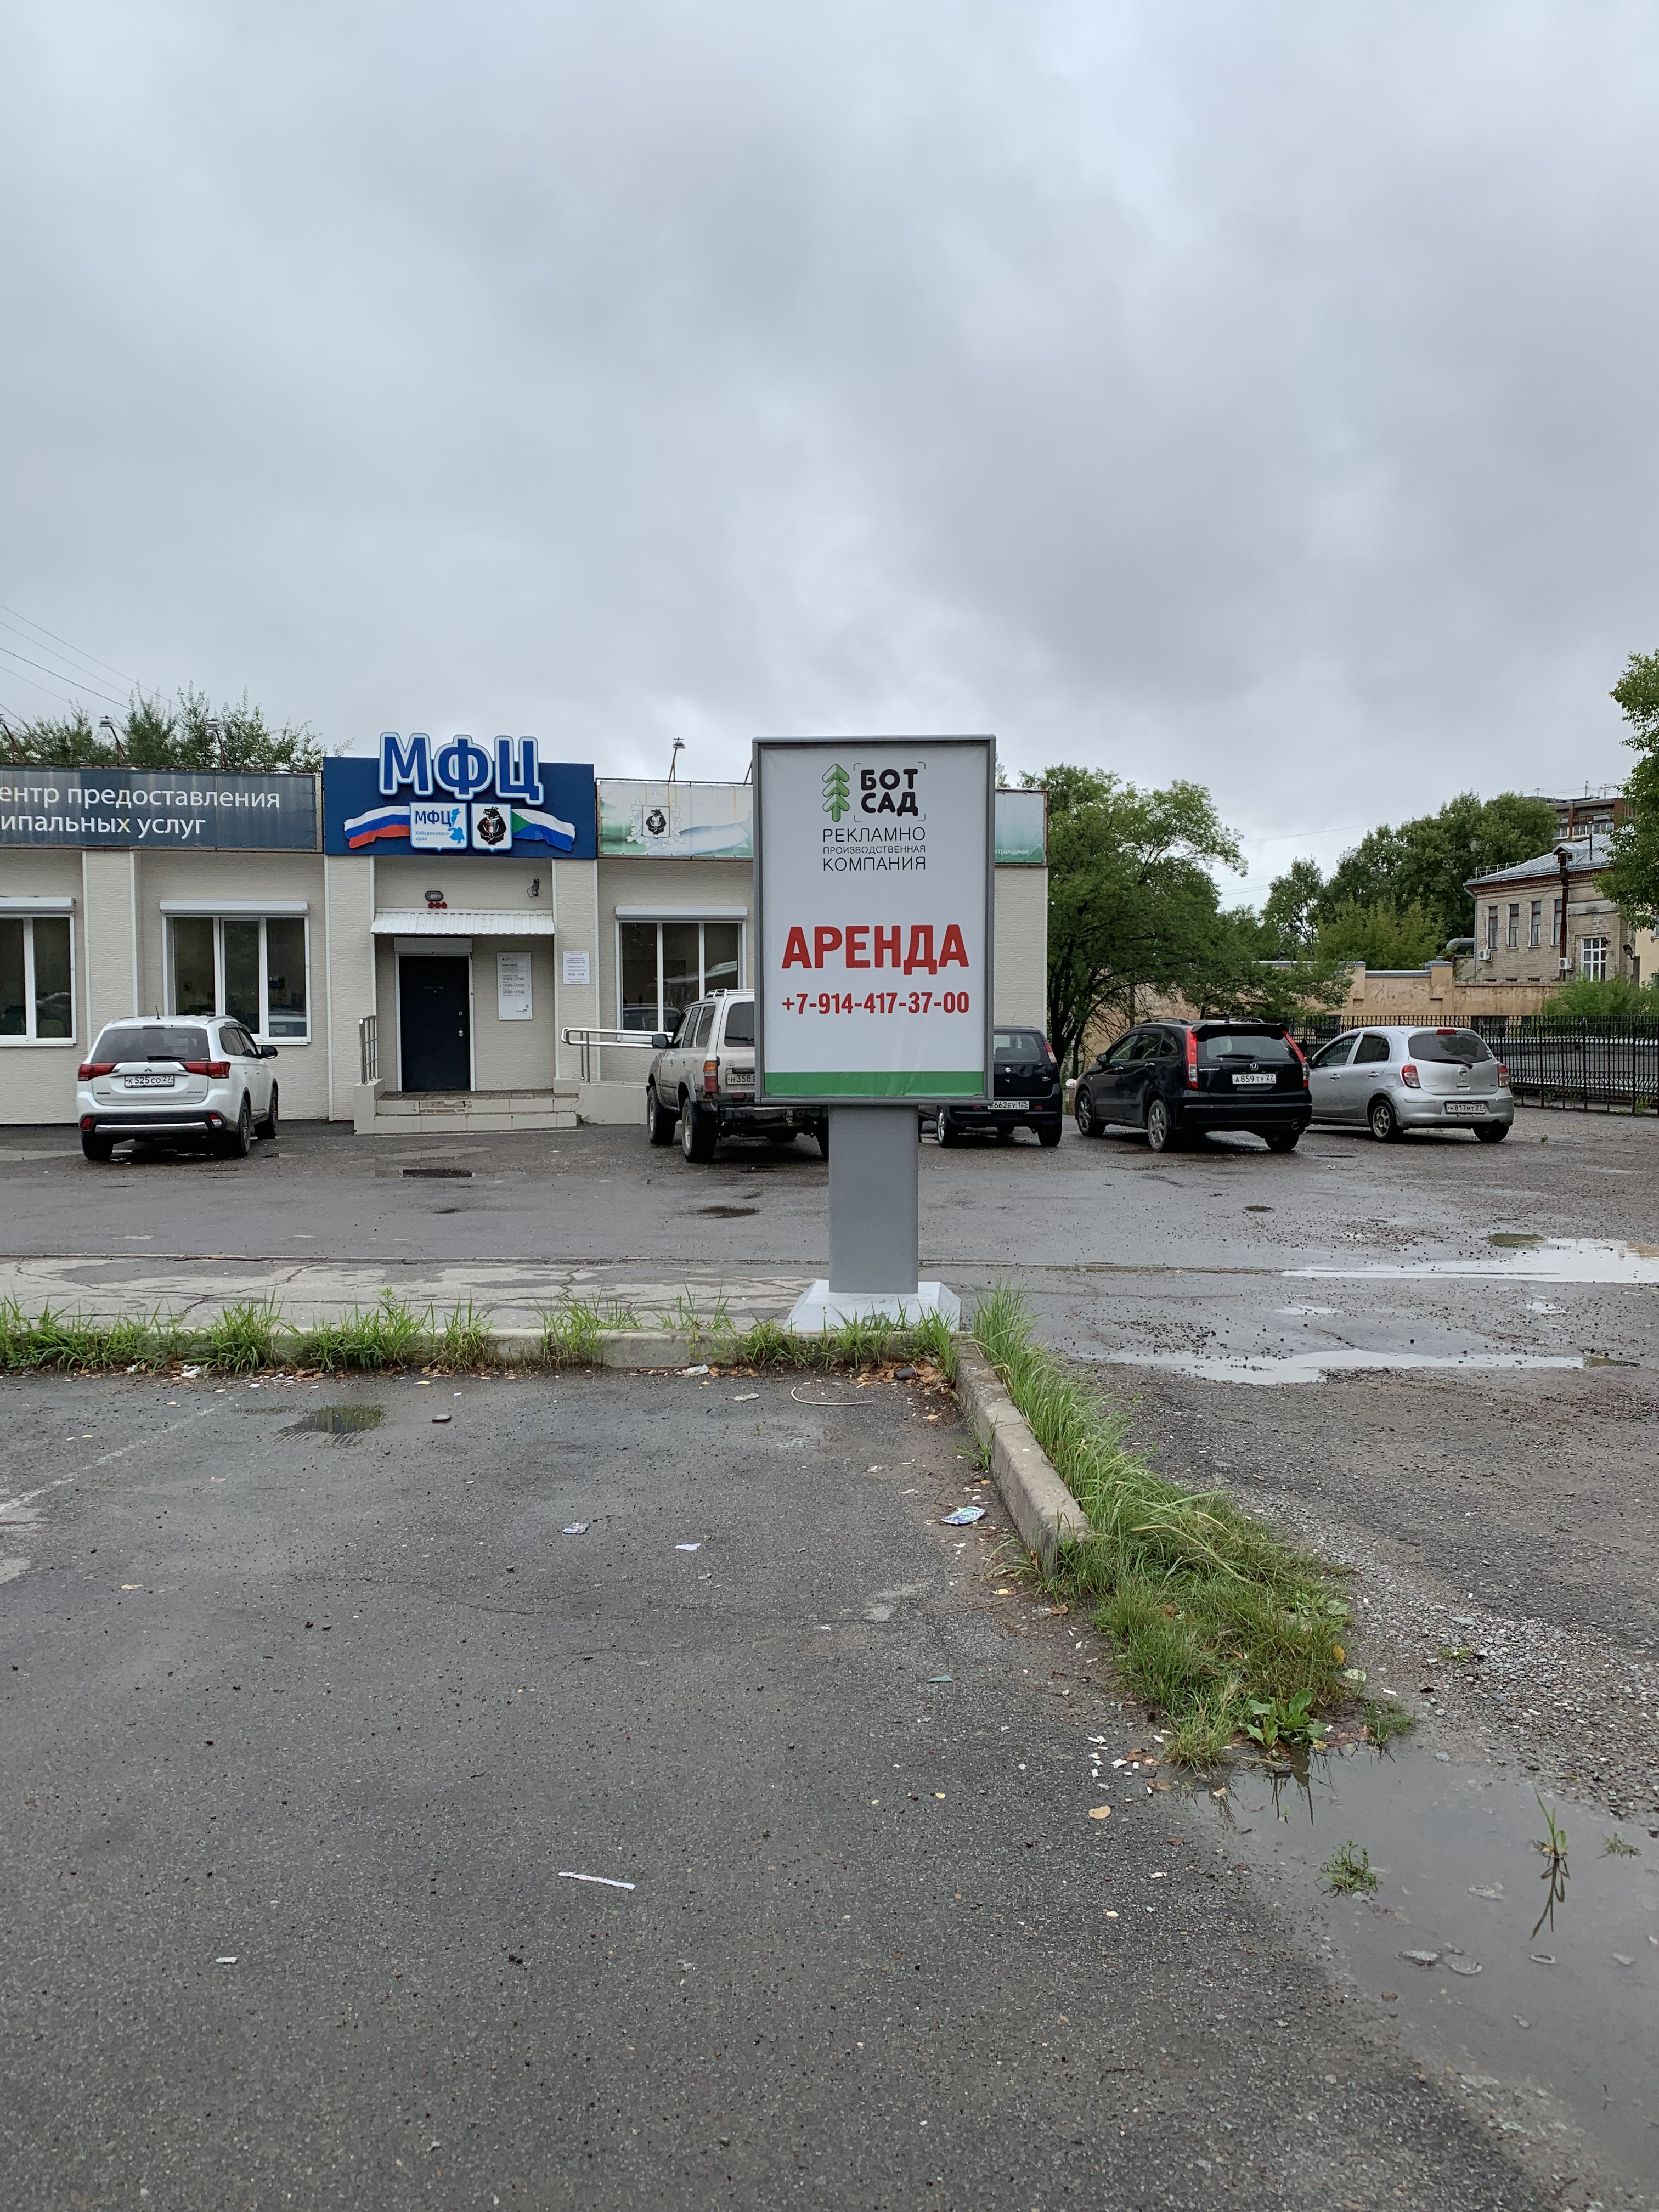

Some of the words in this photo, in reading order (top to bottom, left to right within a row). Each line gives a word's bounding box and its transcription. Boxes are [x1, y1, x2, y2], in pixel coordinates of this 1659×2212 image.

[379, 732, 544, 805] МФЦ
[861, 769, 918, 791] БОТ
[0, 786, 60, 808] ентр
[67, 788, 280, 809] предоставления
[861, 792, 918, 817] САД
[1, 815, 131, 833] ипальных
[137, 818, 206, 839] услуг
[415, 810, 452, 828] МФЦ
[823, 827, 926, 843] РЕКЛАМНО
[823, 845, 926, 855] ПРОИЗВОДСТВЕННАЯ
[823, 856, 926, 871] КОМПАНИЯ
[781, 924, 969, 975] АРЕНДА
[781, 991, 969, 1014] +7-914-417-37-00
